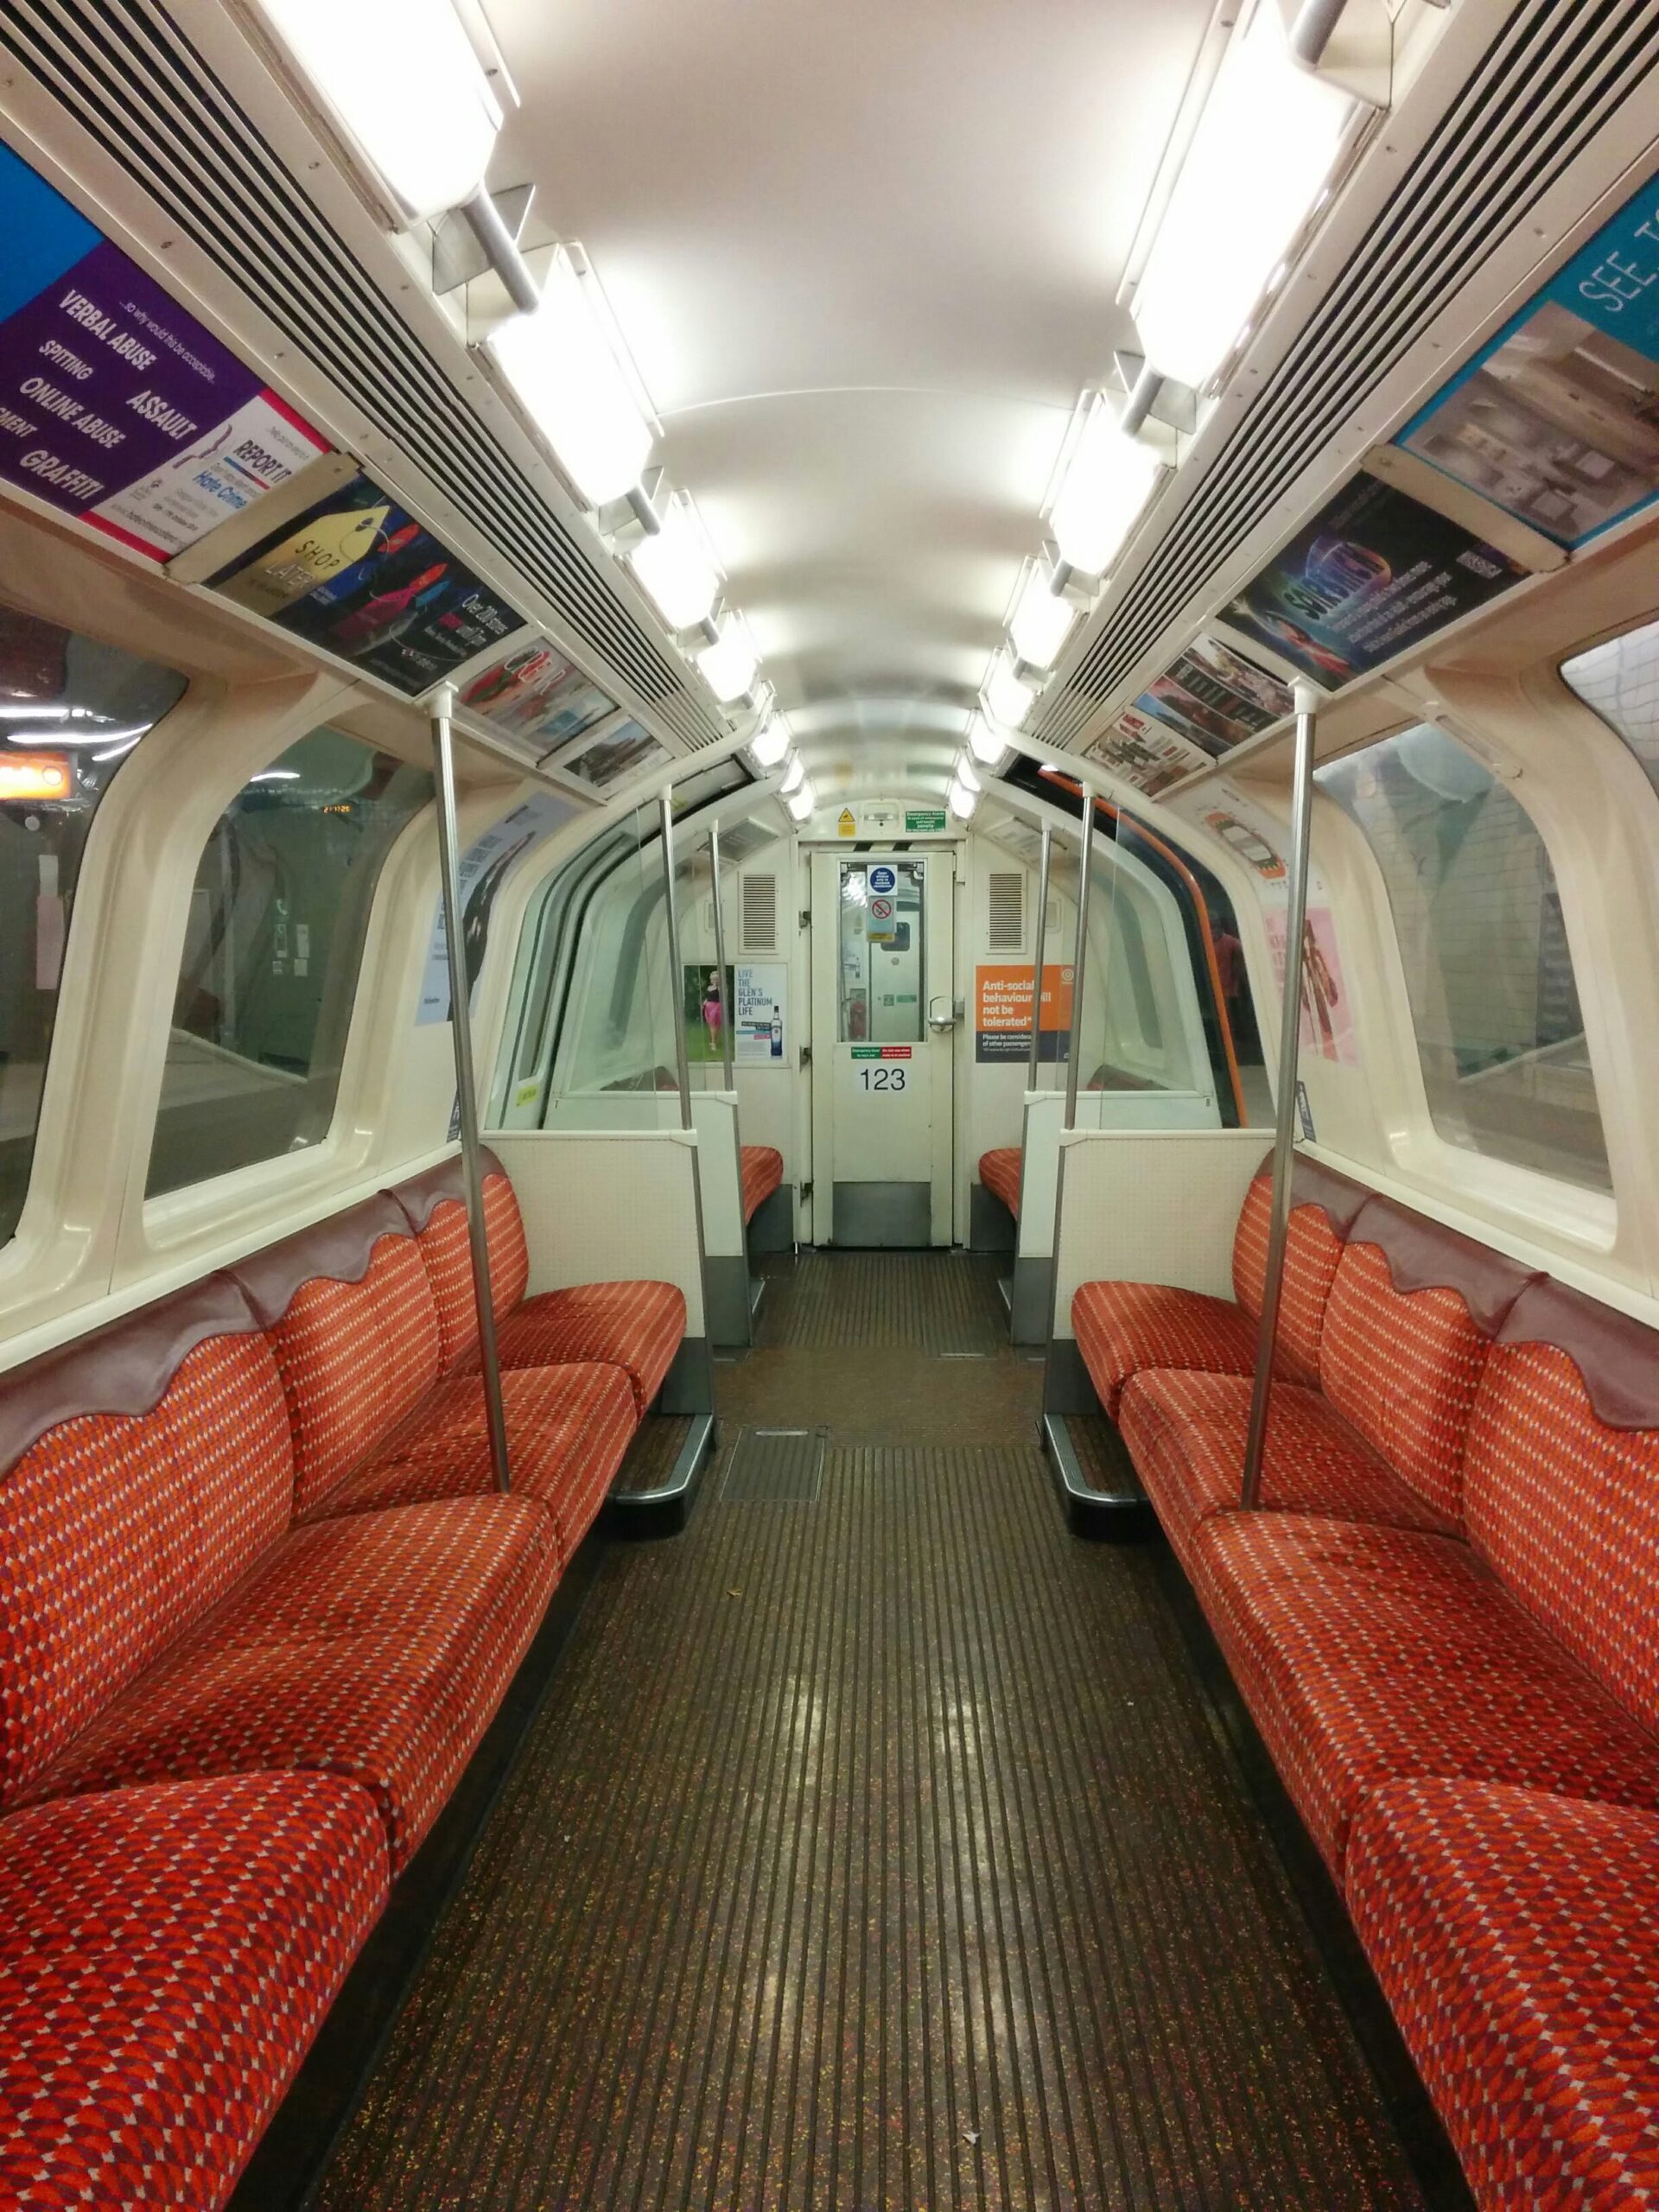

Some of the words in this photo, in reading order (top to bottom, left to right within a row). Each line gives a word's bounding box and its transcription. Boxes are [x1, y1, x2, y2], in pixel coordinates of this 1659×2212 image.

[1579, 251, 1657, 311] SEE
[1634, 209, 1659, 241] T
[59, 289, 117, 340] VERBAL
[106, 332, 158, 372] ABUSE
[133, 308, 149, 325] why
[147, 321, 168, 340] would
[174, 341, 185, 355] be
[39, 339, 93, 380] SPITTING
[20, 377, 85, 421] ONLINE
[72, 413, 126, 448] ABUSE
[125, 390, 198, 440] ASSAULT
[20, 450, 105, 500] GRAFFITI
[233, 439, 283, 477] REPORT
[271, 468, 292, 484] IT
[192, 470, 221, 493] Hate
[217, 486, 247, 509] Crime
[265, 563, 315, 587] LATER
[295, 540, 340, 570] SHOP
[461, 594, 483, 614] Over
[486, 617, 508, 635] stores
[982, 981, 1035, 990] Anti-social
[983, 993, 1033, 1002] behaviour
[1040, 992, 1052, 1001] ill
[983, 1005, 1002, 1014] not
[1001, 1005, 1014, 1014] be
[860, 1068, 906, 1090] 123
